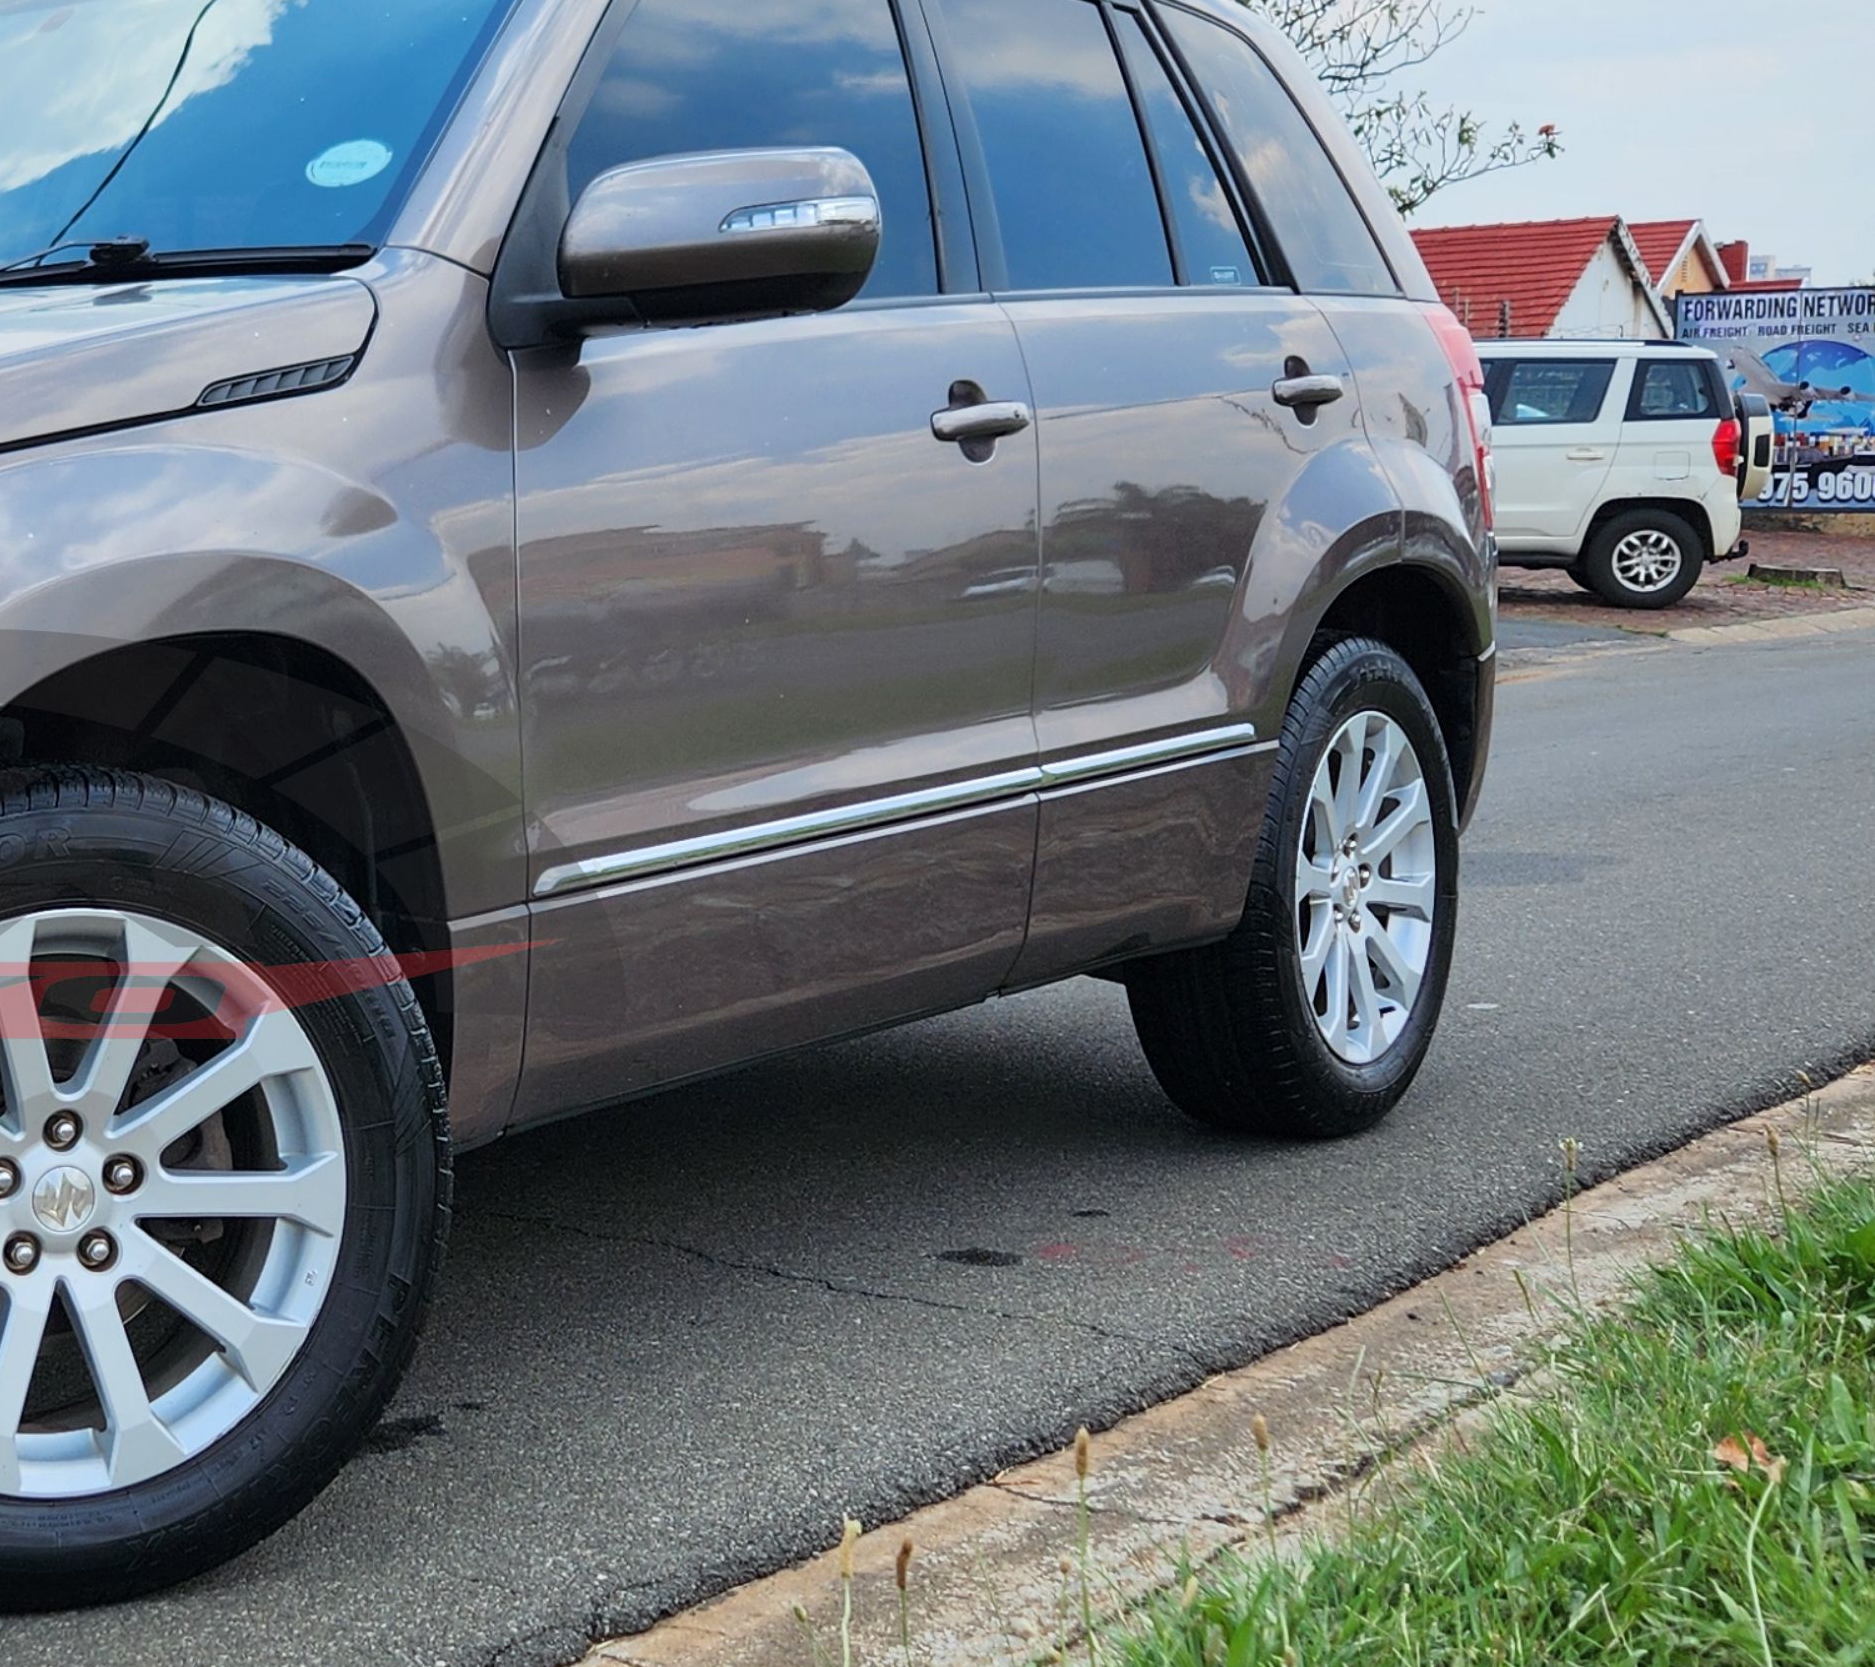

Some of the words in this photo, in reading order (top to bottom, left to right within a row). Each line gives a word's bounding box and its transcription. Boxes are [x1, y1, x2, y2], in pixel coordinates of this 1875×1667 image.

[1684, 296, 1797, 321] FORWARDING
[1804, 294, 1875, 317] NETWOR
[1682, 327, 1701, 338] AIR
[1703, 325, 1747, 339] FREIGHT
[1758, 324, 1788, 336] ROAD
[1792, 323, 1837, 336] FREIGHT
[1848, 322, 1870, 333] SEA
[1818, 472, 1875, 500] 960
